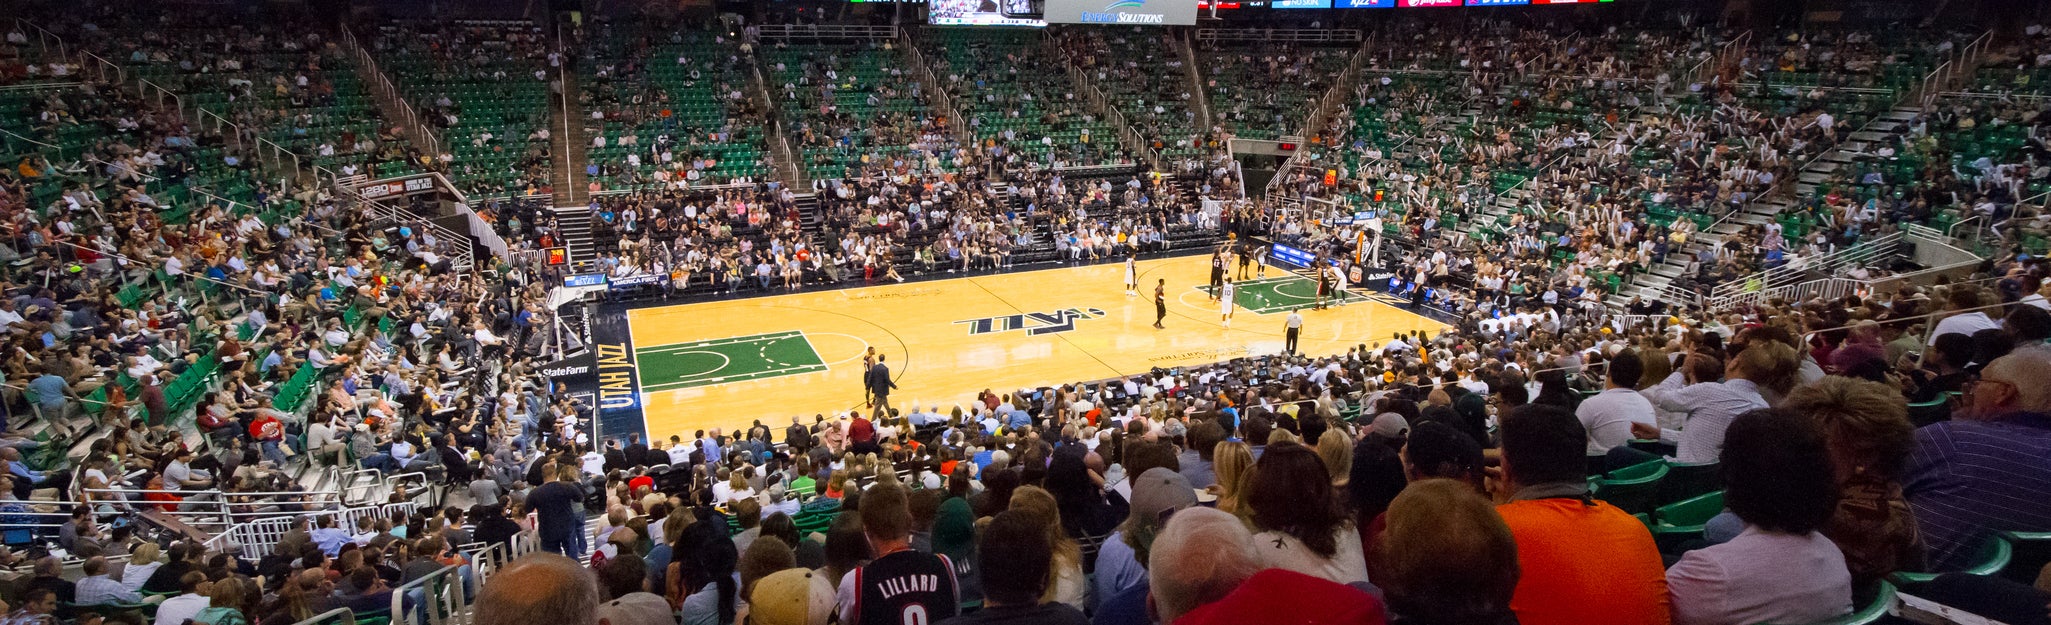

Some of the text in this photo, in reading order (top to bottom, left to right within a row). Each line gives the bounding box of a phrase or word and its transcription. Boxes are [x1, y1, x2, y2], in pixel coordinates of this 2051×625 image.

[360, 184, 389, 195] 1280
[612, 279, 640, 287] AMERICA
[1224, 289, 1232, 297] 10
[597, 343, 635, 409] UTAH JAZZ
[877, 574, 938, 600] LILLARD
